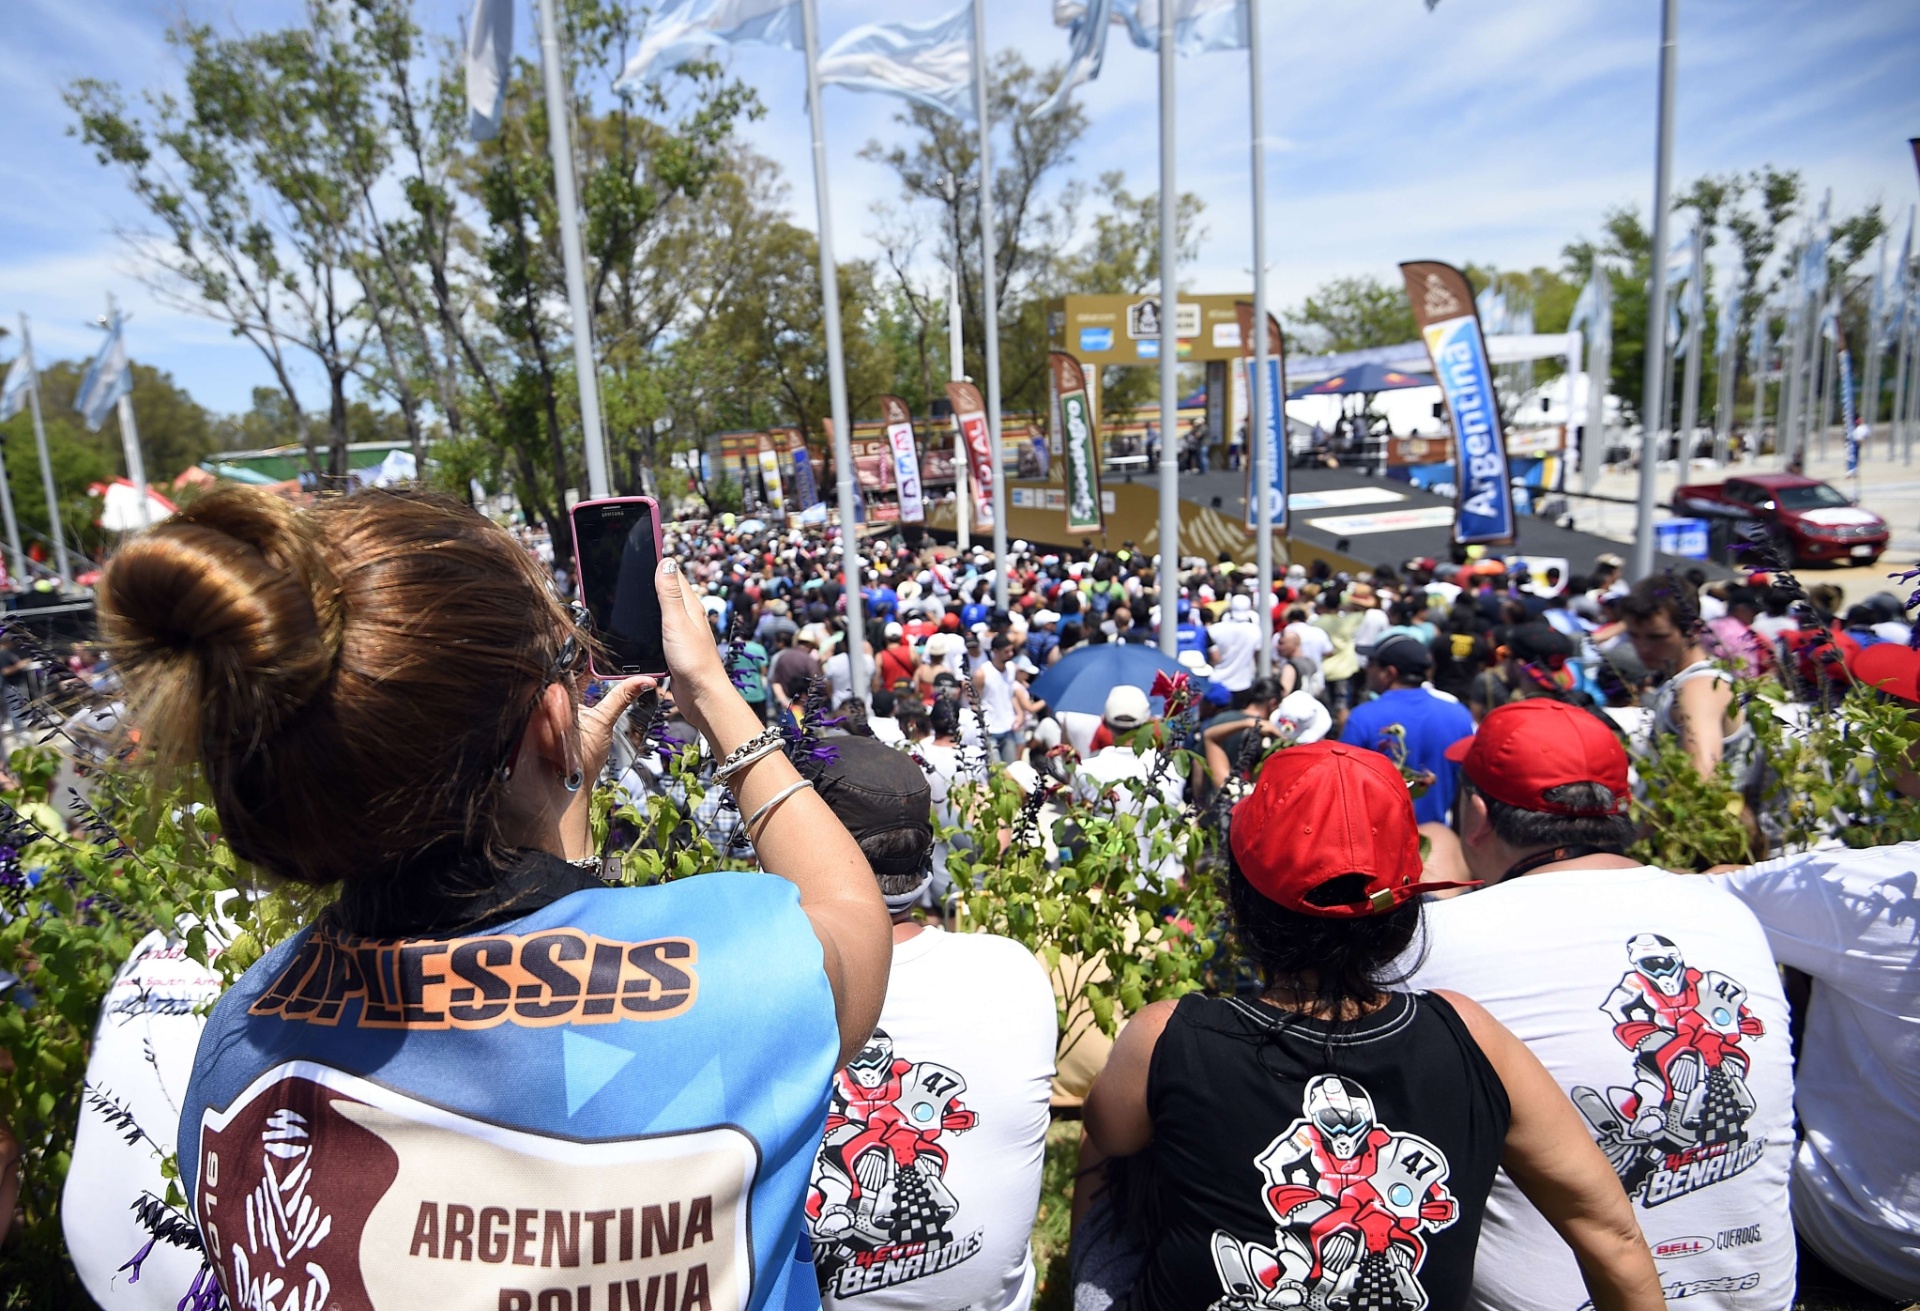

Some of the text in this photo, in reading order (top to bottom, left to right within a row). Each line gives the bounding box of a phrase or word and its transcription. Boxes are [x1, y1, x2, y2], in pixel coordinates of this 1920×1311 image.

[1443, 340, 1503, 518] Argentina
[1714, 980, 1741, 1004] 47
[922, 1072, 958, 1098] 47
[1401, 1151, 1438, 1181] 47
[409, 1195, 714, 1267] ARGENTINA
[836, 1226, 984, 1299] BENAVIDES
[1656, 1241, 1703, 1254] BELL
